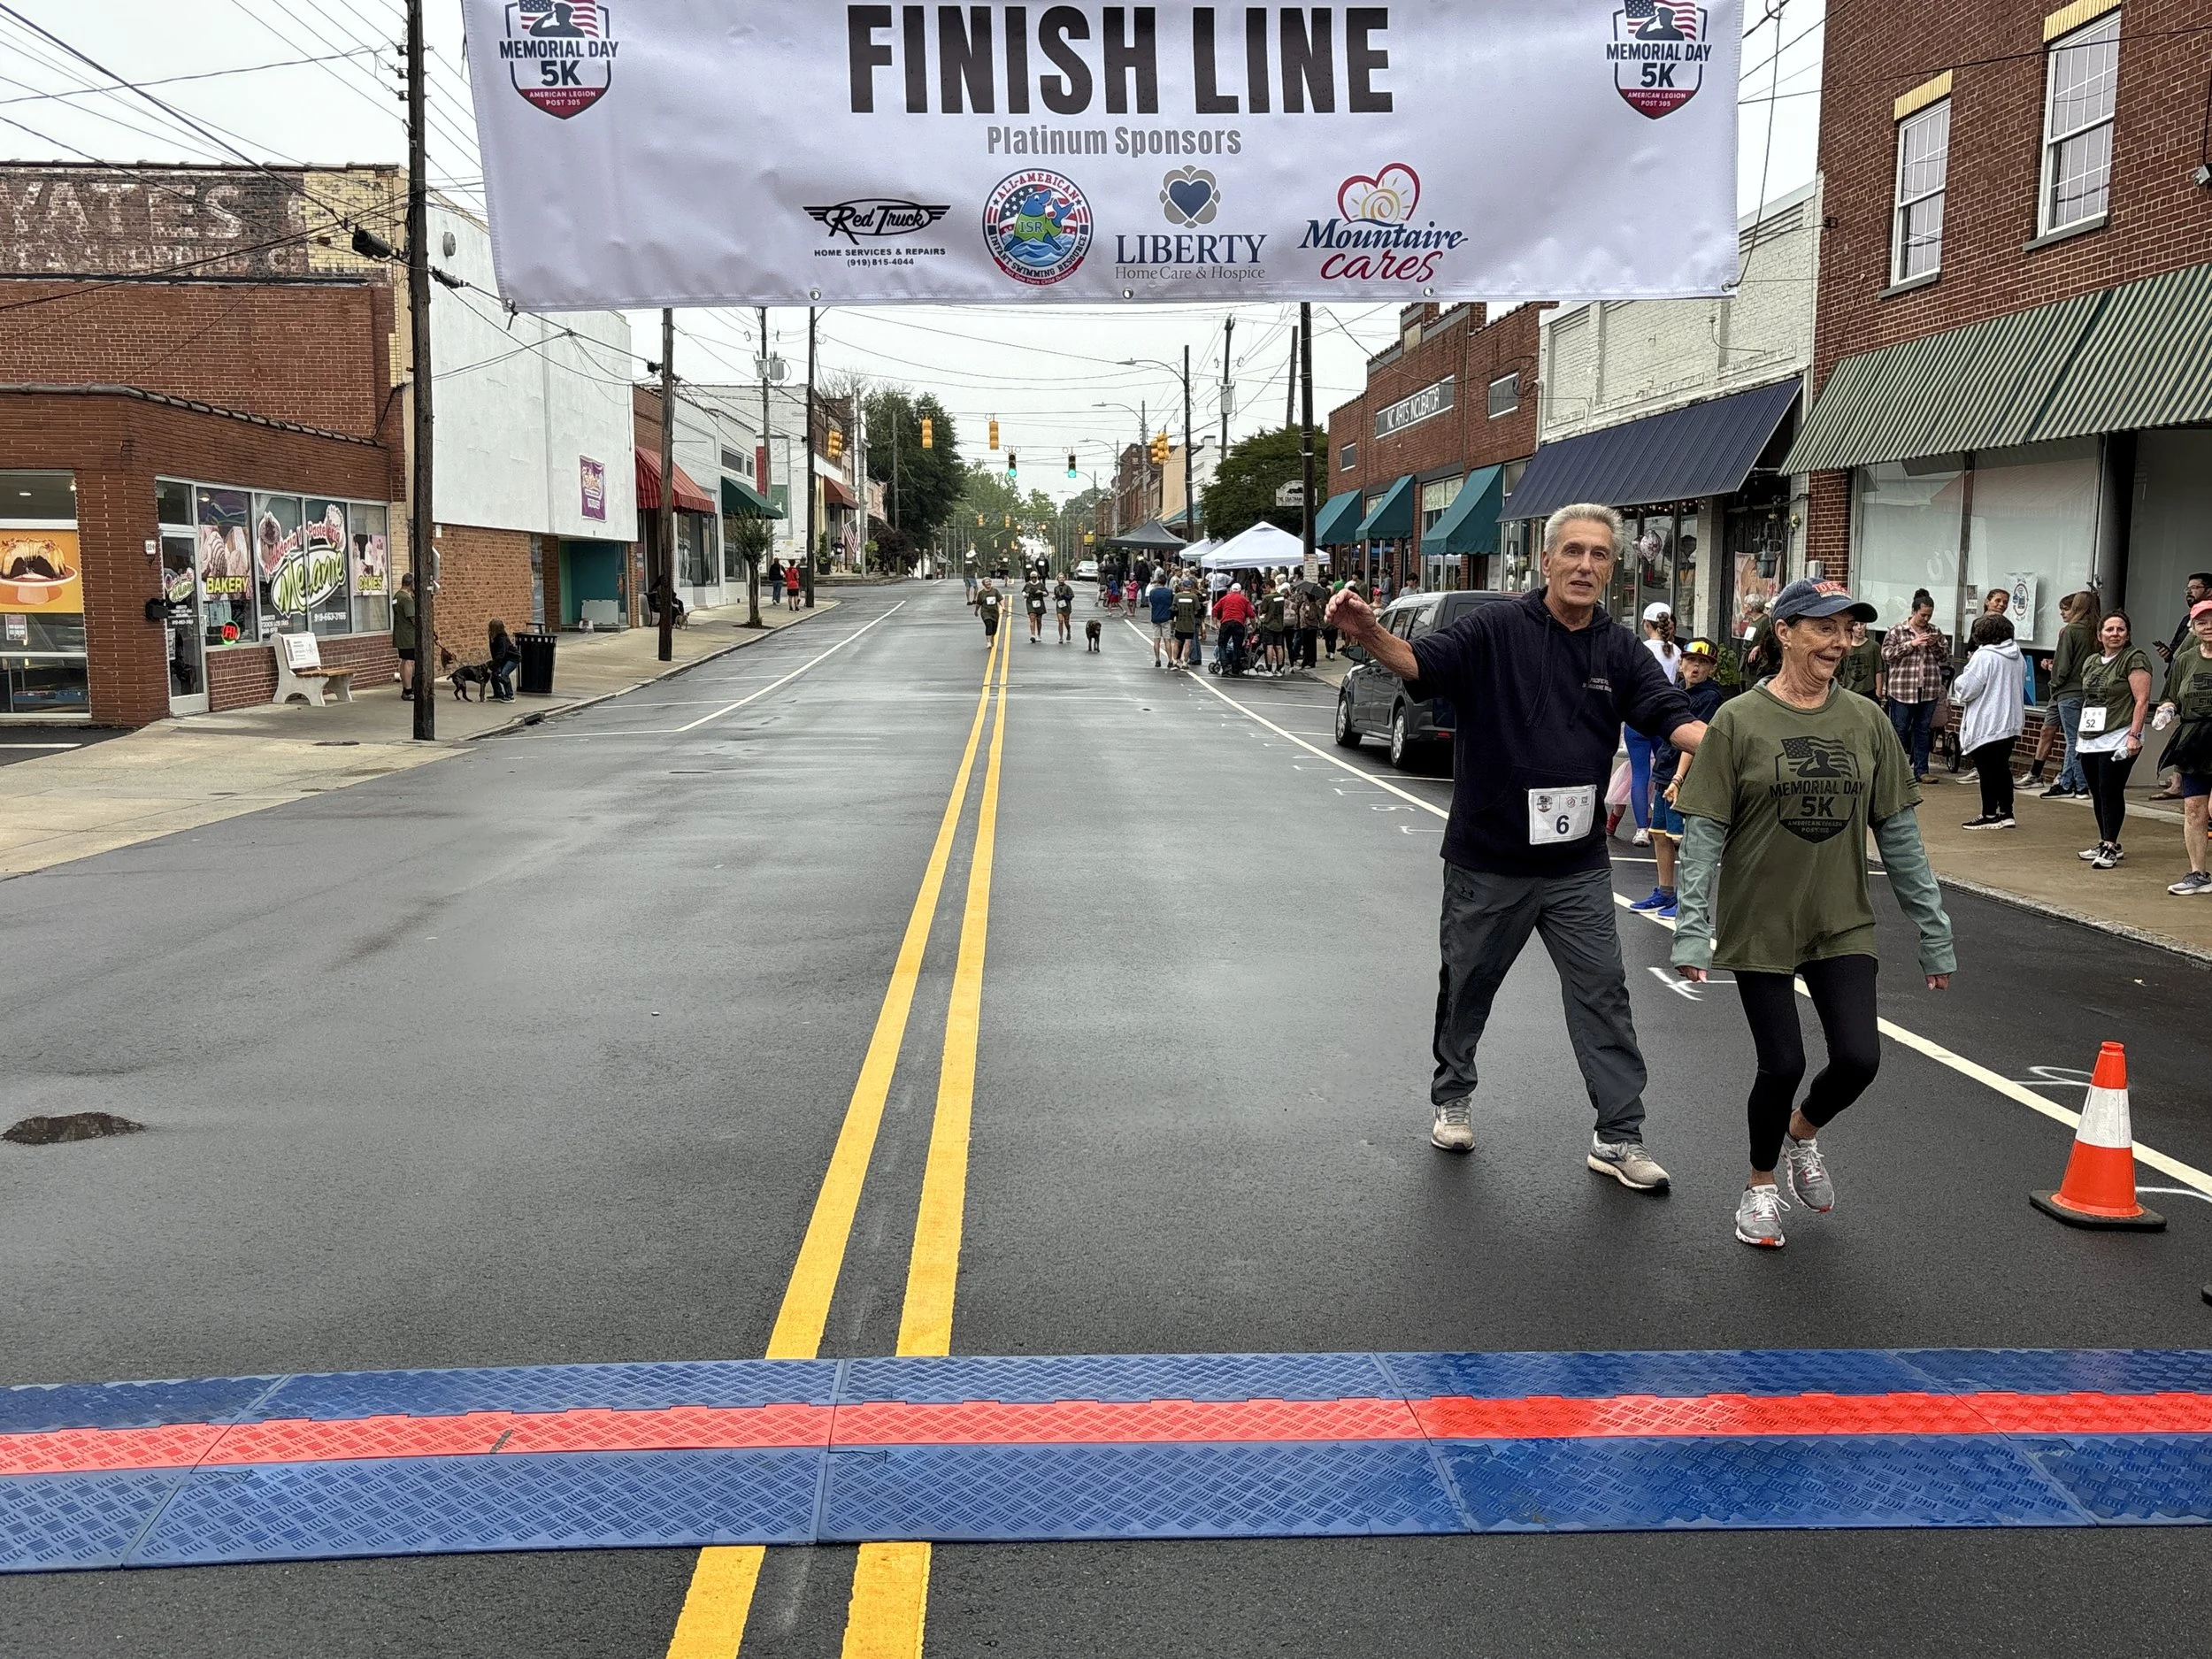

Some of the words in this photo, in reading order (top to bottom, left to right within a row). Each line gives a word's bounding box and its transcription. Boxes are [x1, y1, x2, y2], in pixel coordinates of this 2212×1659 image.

[499, 40, 584, 58] MEMORIAL
[588, 41, 619, 58] DAY
[848, 4, 1158, 115] FINISH
[1194, 6, 1394, 114] LINE
[1607, 43, 1682, 60] MEMORIAL
[1685, 44, 1712, 62] DAY
[541, 60, 582, 86] 5K
[1640, 63, 1677, 88] 5K
[987, 126, 1107, 155] Platinum
[1115, 126, 1242, 157] Sponsors
[997, 173, 1079, 201] ALL-AMERICAN
[828, 206, 876, 245] Red
[874, 205, 925, 234] Truck
[1020, 221, 1043, 232] ISR
[1297, 218, 1469, 250] Mountaire
[990, 235, 1013, 265] INFANT
[1011, 262, 1056, 278] SWIMMING
[1056, 235, 1087, 272] RESOURCE
[1115, 234, 1267, 265] LIBERTY
[1195, 266, 1207, 279] &
[1210, 265, 1265, 282] Hospice
[1320, 250, 1443, 282] cares
[1386, 410, 1394, 430] NC
[1395, 403, 1409, 426] ARTS
[1410, 388, 1440, 420] INCUBATOR
[206, 576, 249, 594] BAKERY
[277, 542, 344, 615] Meanie
[358, 576, 382, 590] CAKES
[2085, 718, 2096, 728] 52
[1769, 780, 1839, 797] MEMORIAL
[1843, 780, 1865, 795] DAY
[1800, 796, 1835, 818] 5K
[1556, 814, 1570, 834] 6
